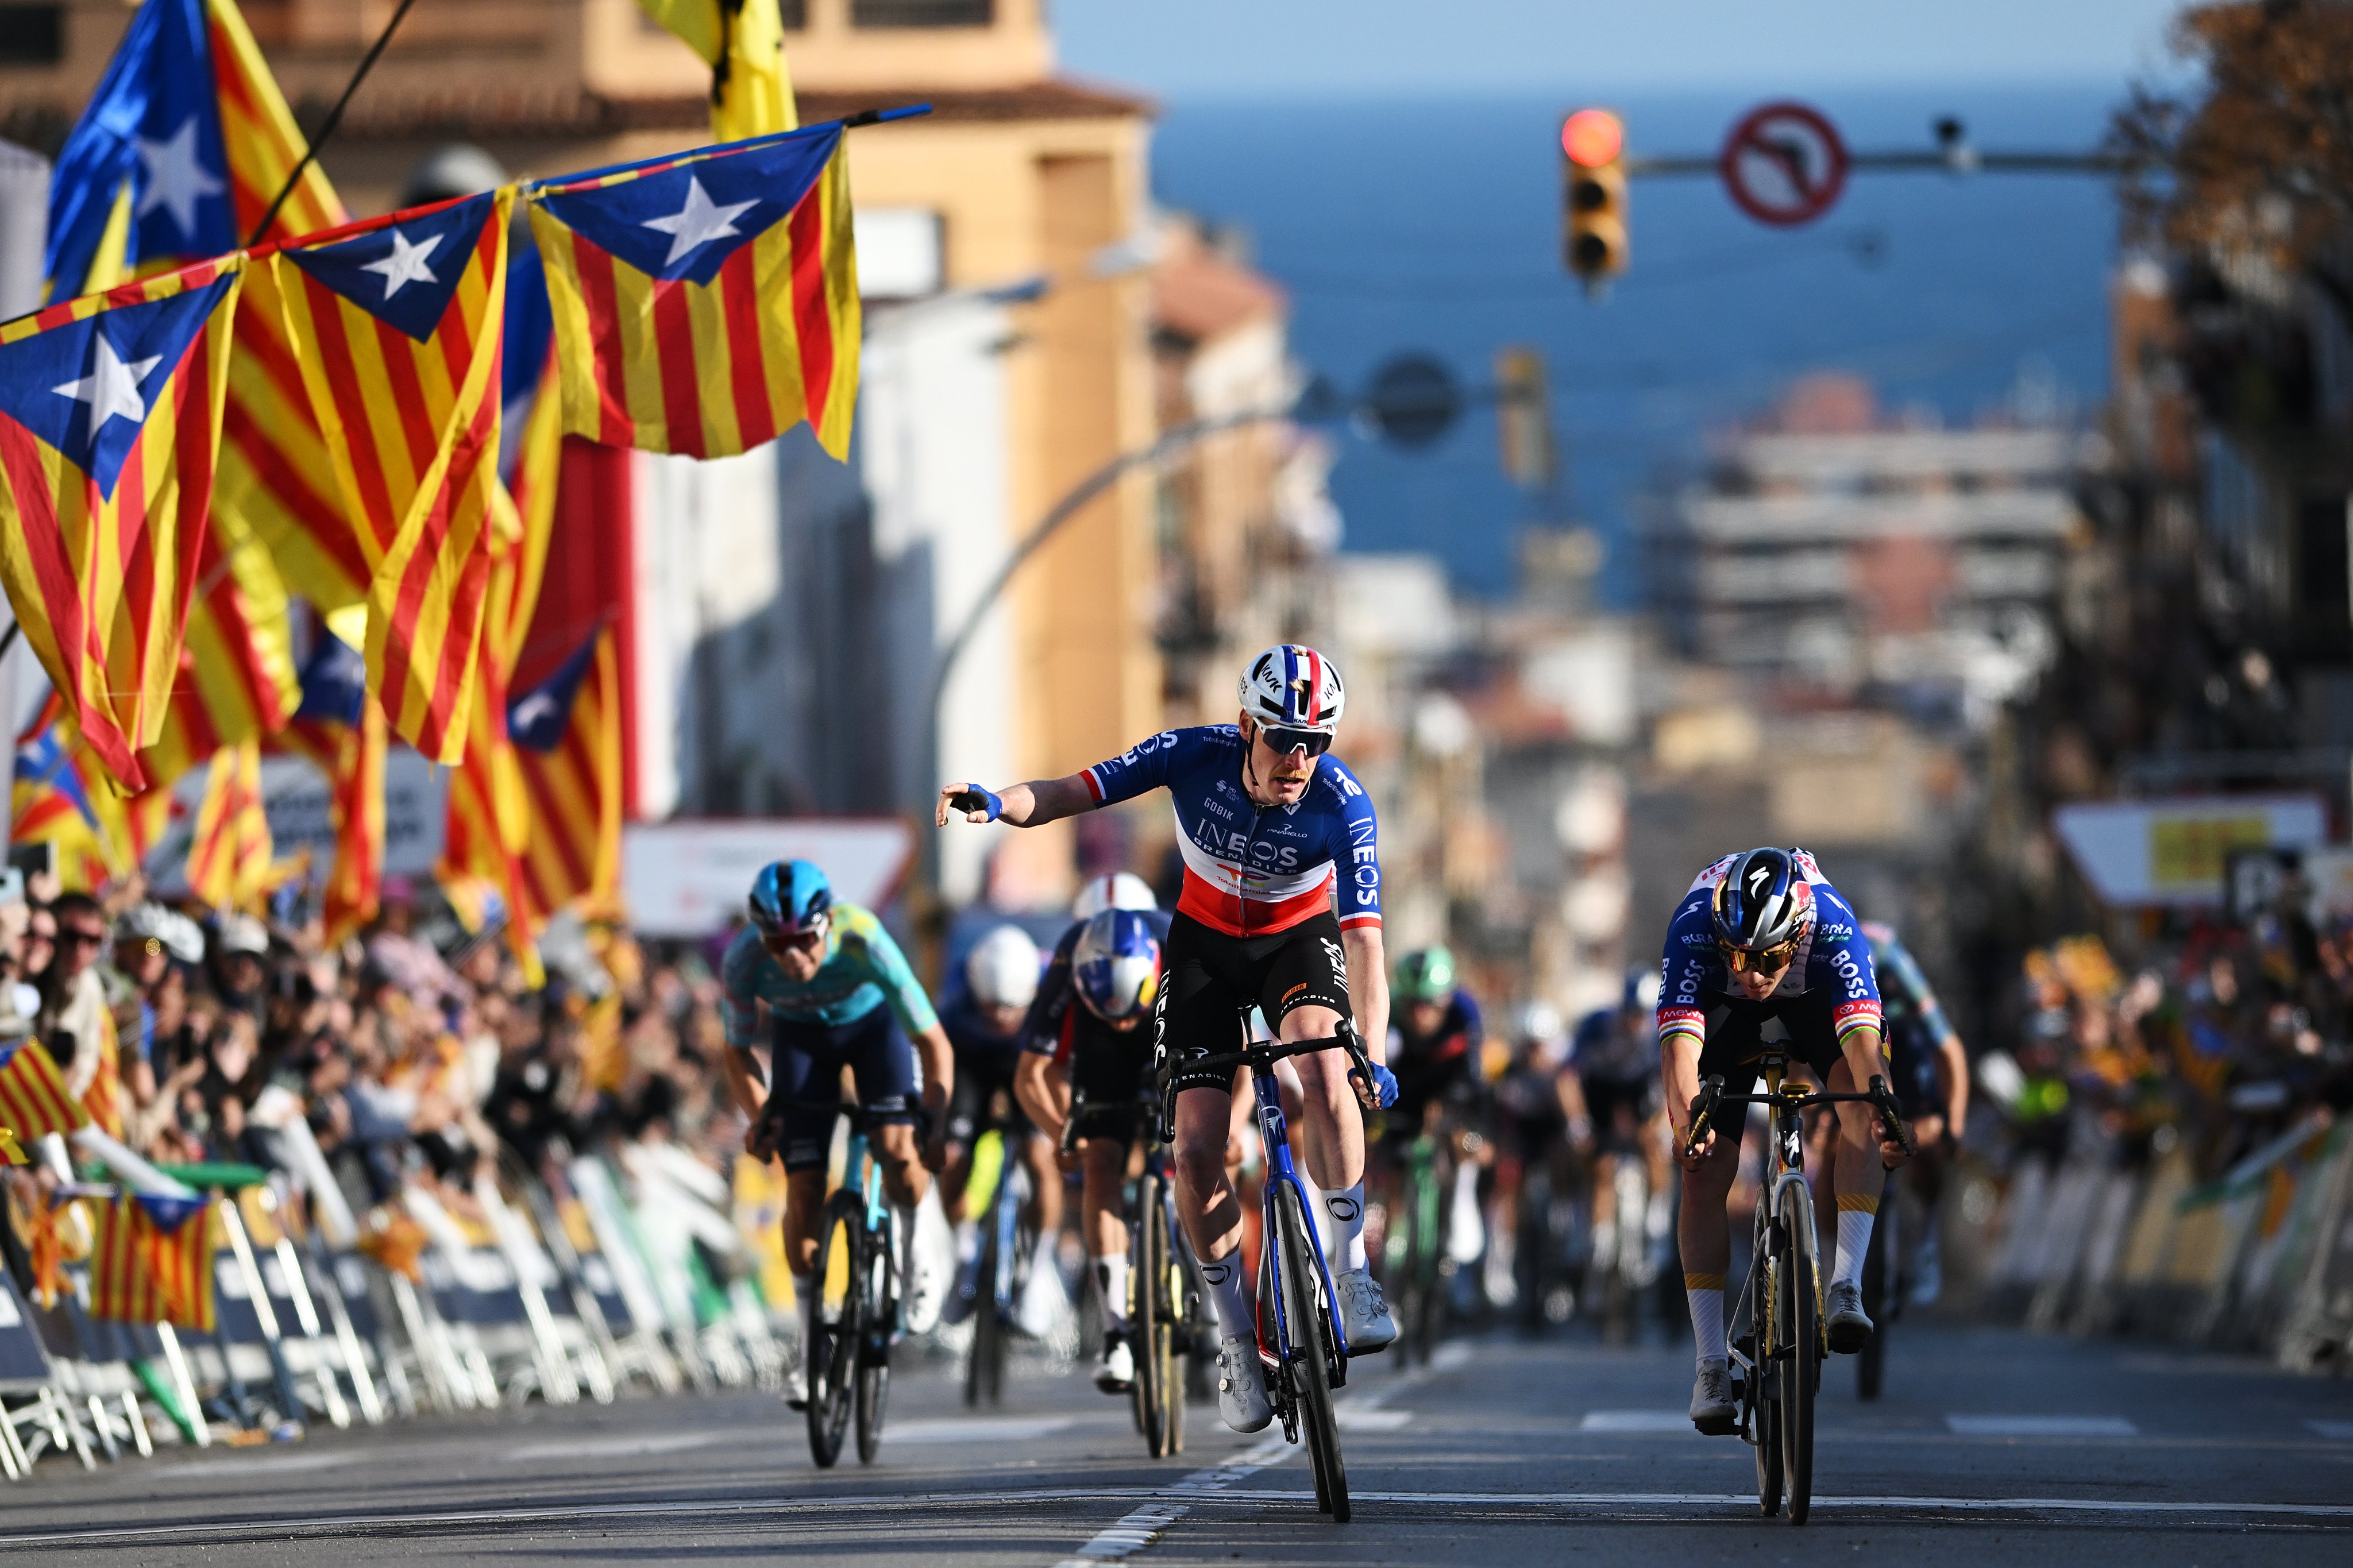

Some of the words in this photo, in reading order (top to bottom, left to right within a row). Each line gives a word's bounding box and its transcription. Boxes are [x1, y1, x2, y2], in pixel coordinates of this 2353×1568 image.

[1262, 664, 1282, 694] KASK
[1322, 778, 1348, 805] TotalEnergies
[1203, 797, 1234, 821] GOBIK
[1196, 817, 1298, 867] INEOS
[1267, 828, 1307, 838] PINARELLO
[1349, 816, 1379, 906] INEOS
[1676, 959, 1706, 1004] BOSS
[1829, 949, 1868, 999] BOSS
[1182, 1073, 1226, 1082] ENADIER
